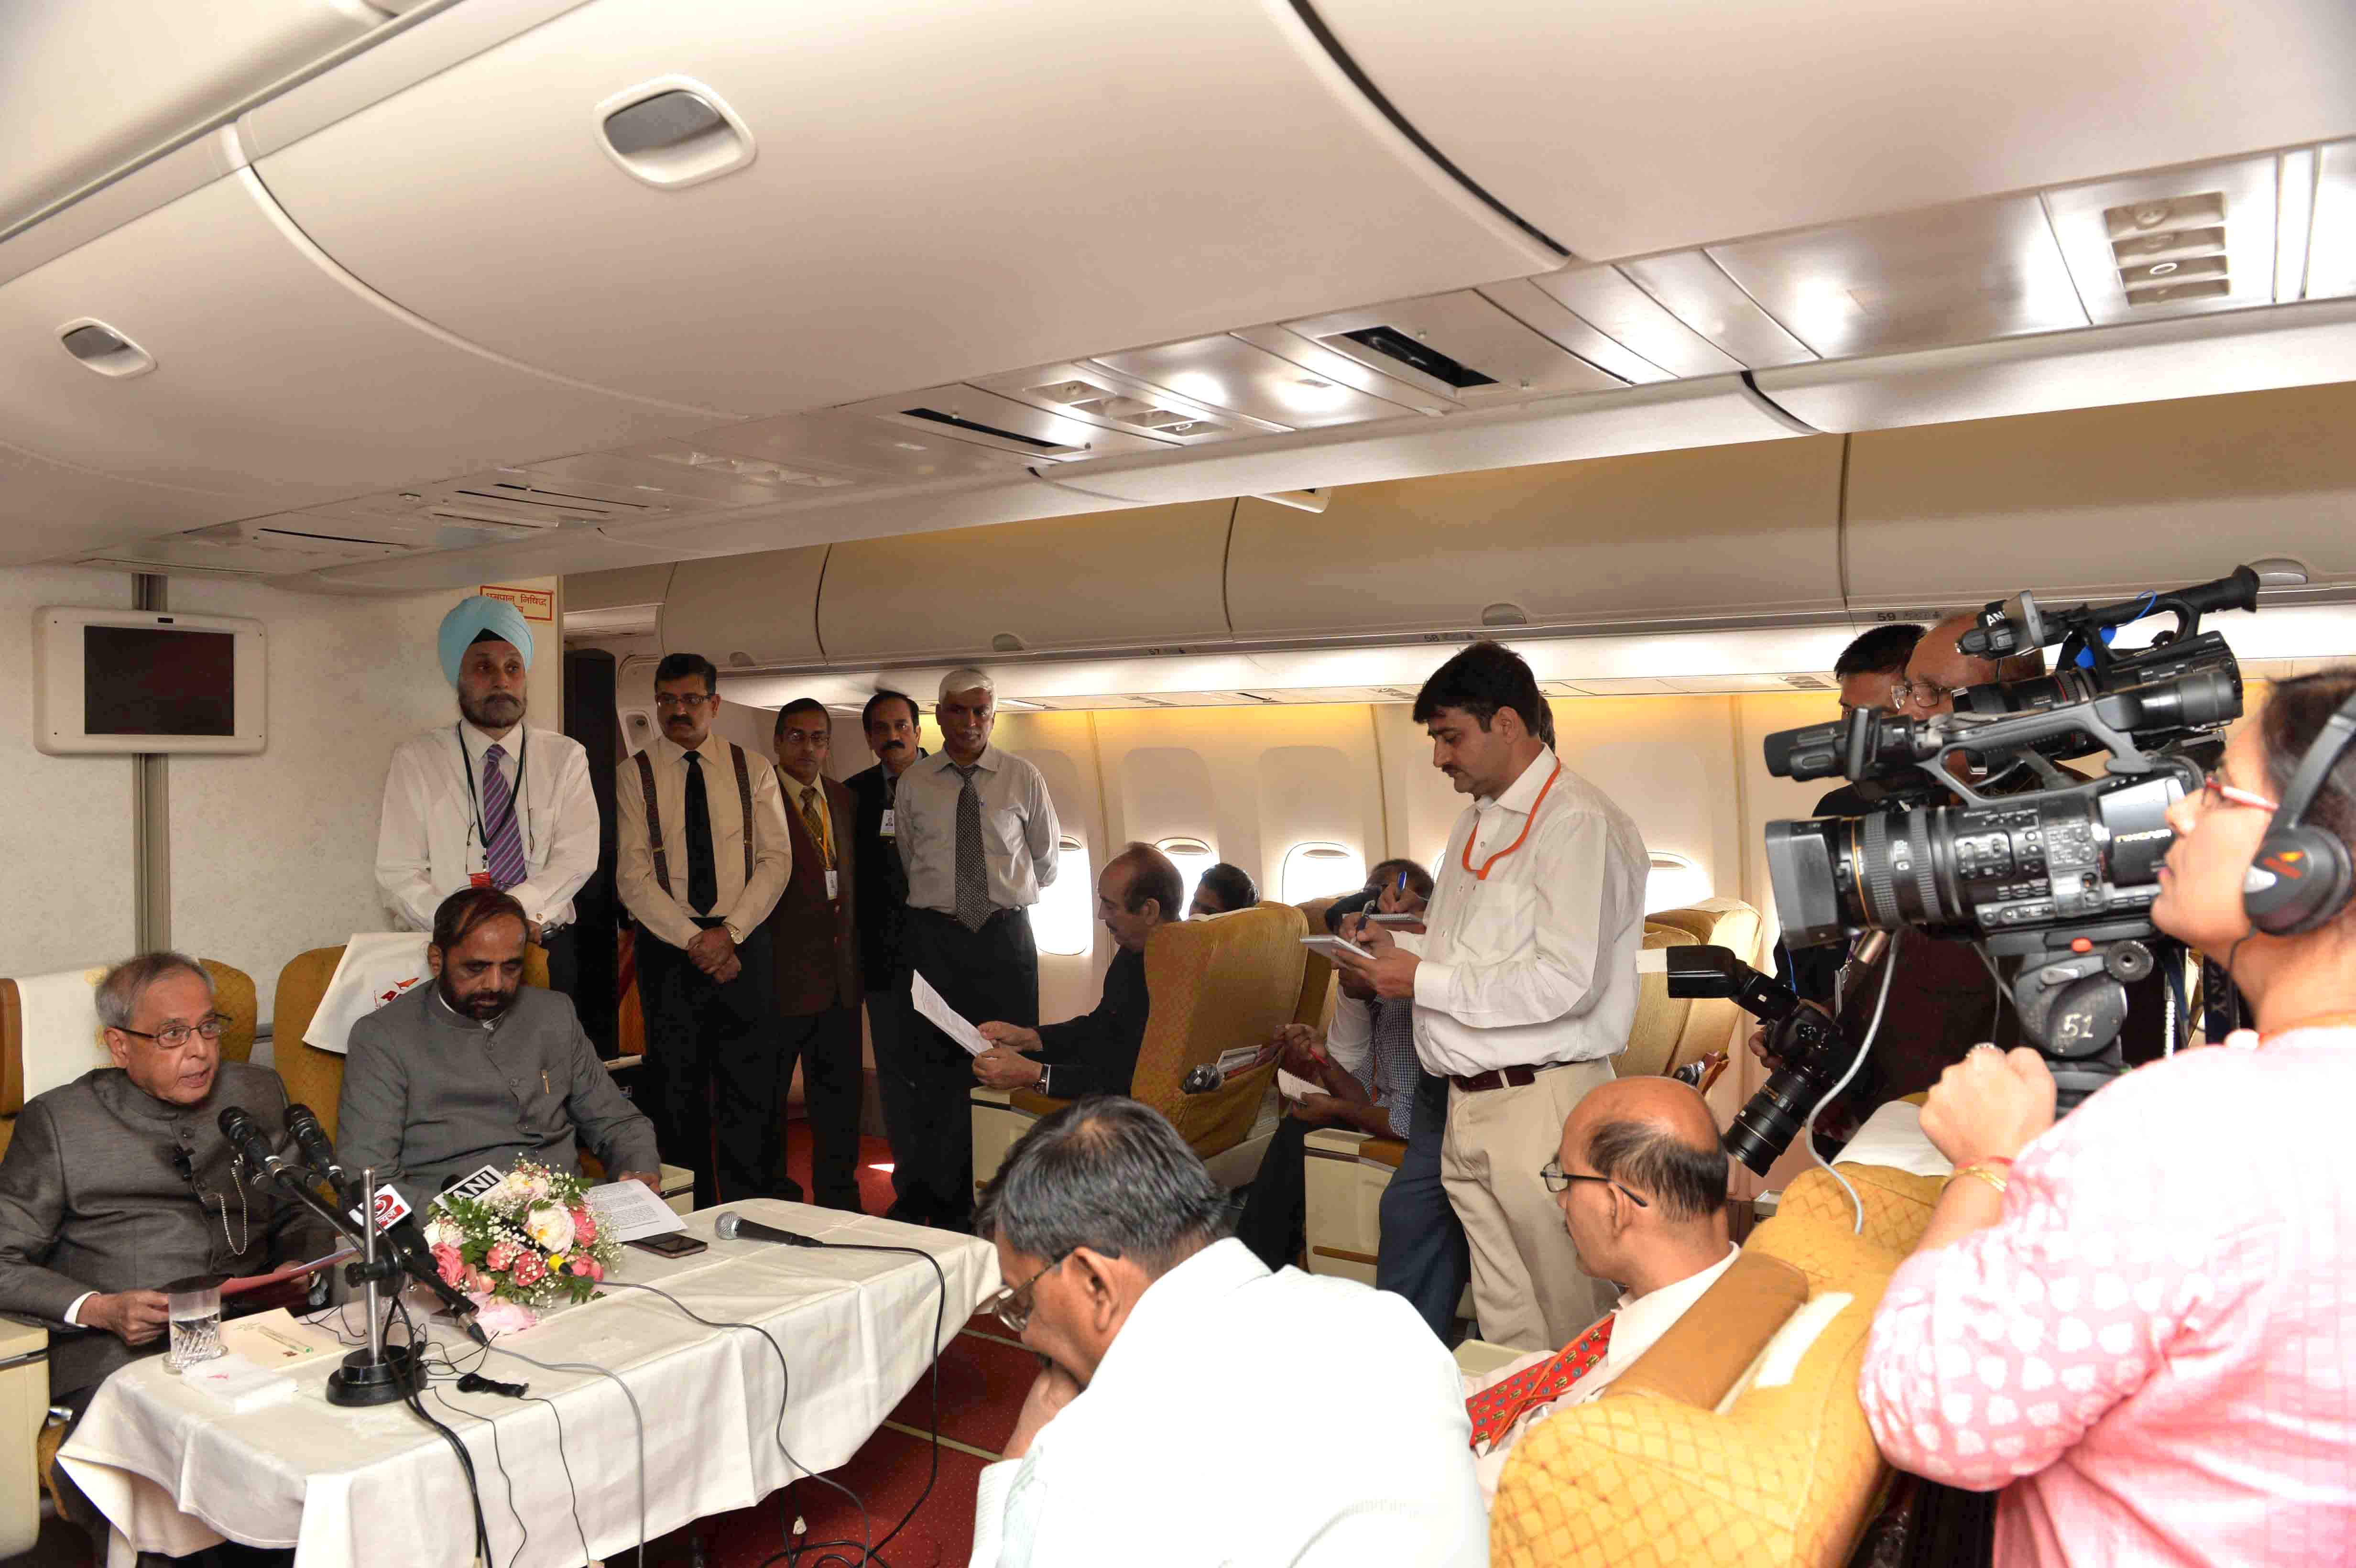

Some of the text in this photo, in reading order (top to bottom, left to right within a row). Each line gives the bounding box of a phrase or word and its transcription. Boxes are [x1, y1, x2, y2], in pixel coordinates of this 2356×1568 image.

[1877, 612, 1896, 621] 59
[2060, 1013, 2094, 1038] 51
[453, 1172, 497, 1200] ANI
